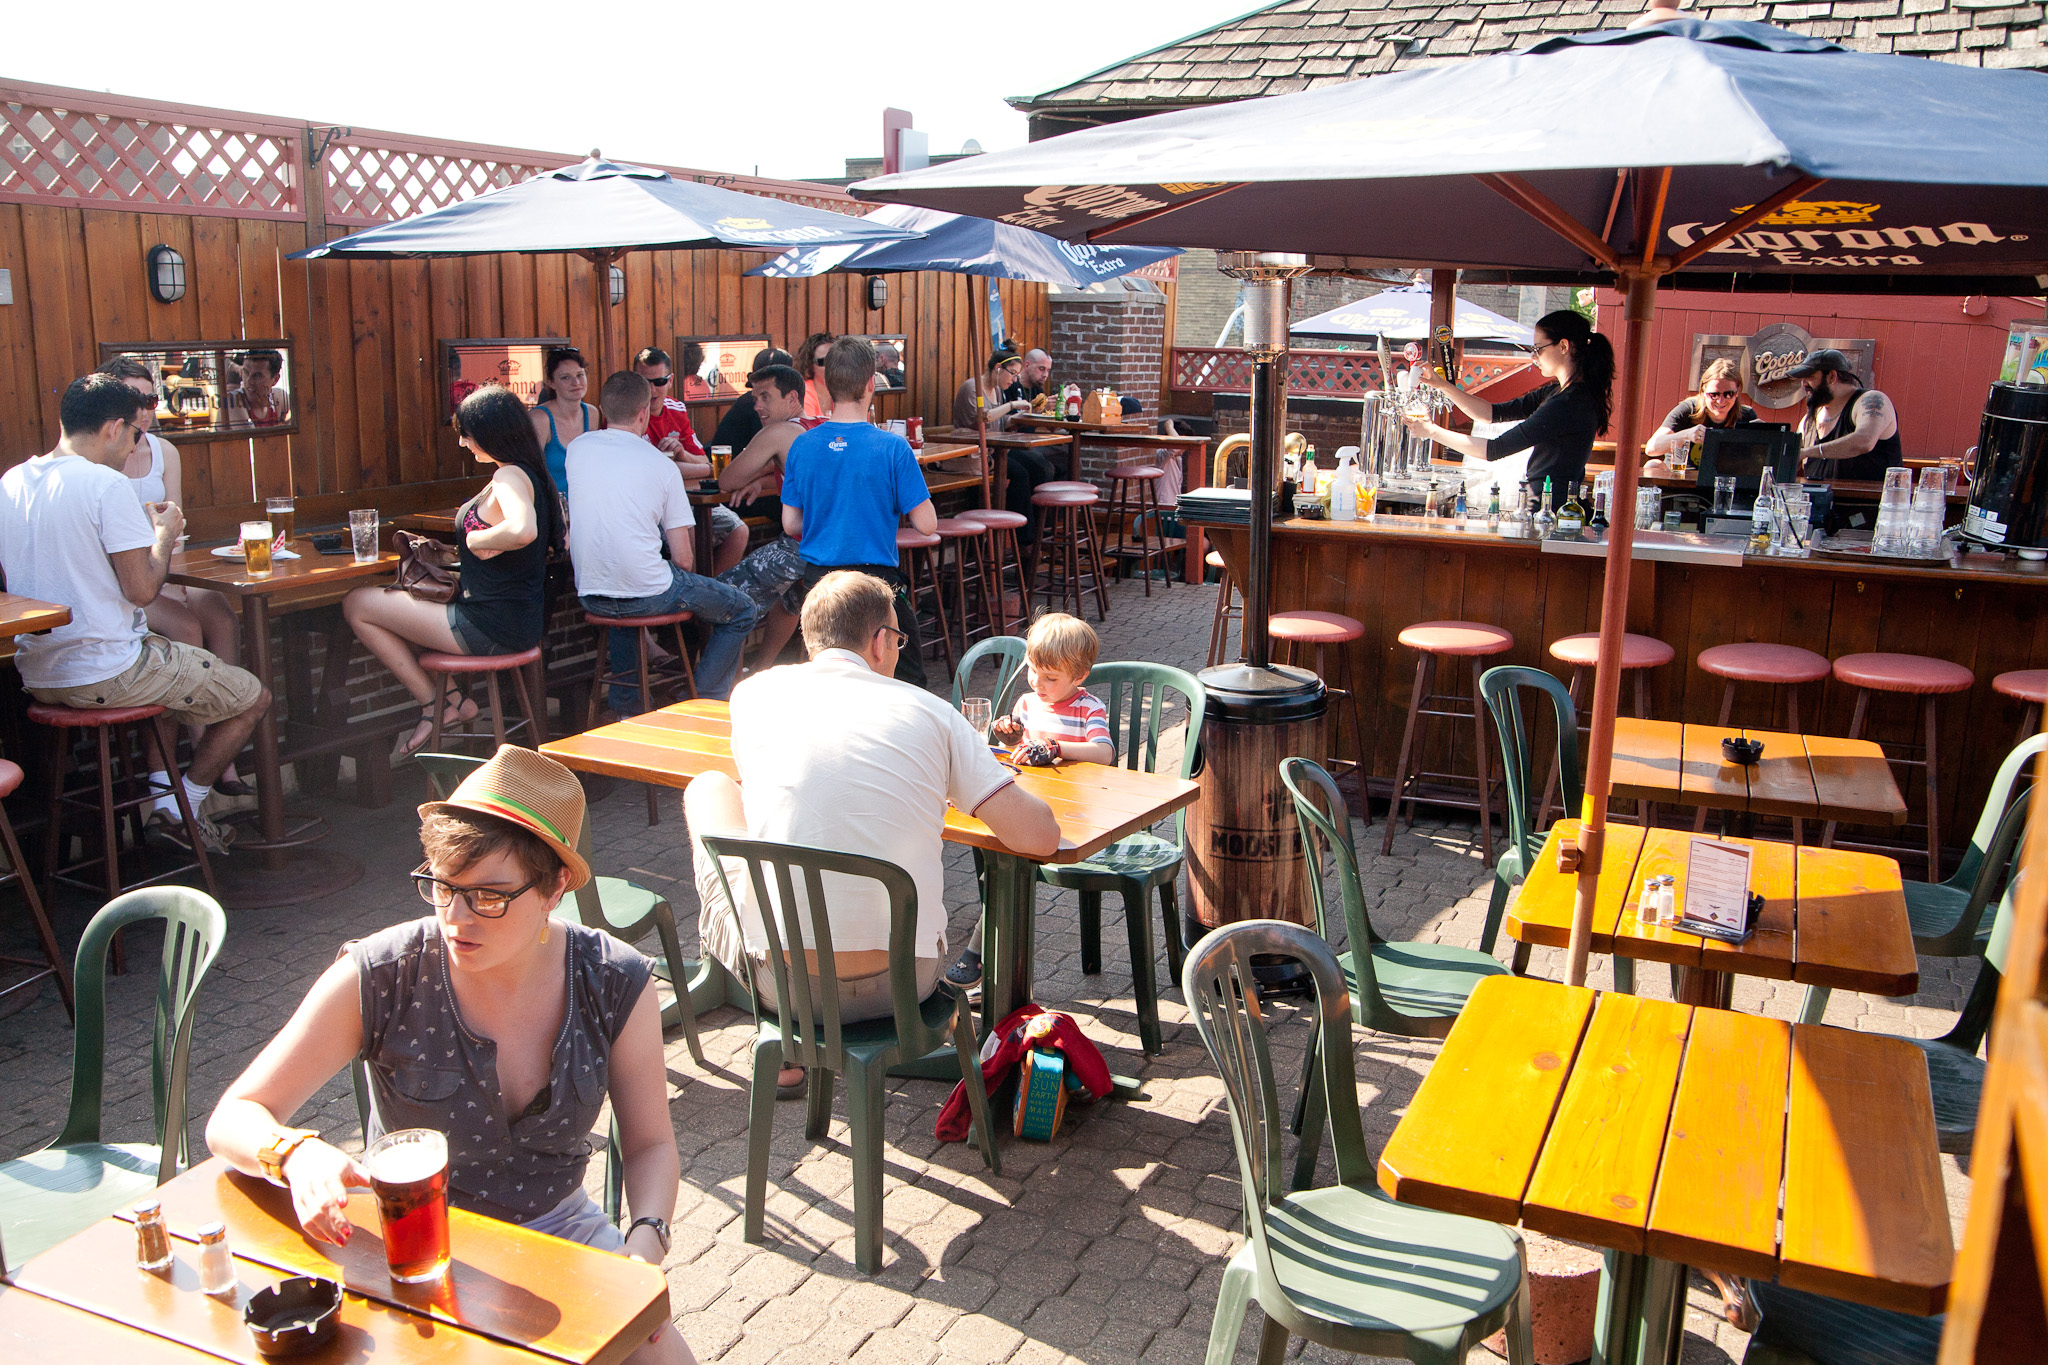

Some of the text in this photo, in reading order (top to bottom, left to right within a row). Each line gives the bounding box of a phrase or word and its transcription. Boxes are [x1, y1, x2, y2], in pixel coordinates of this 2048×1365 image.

[1668, 222, 2006, 257] Corona
[1057, 239, 1130, 268] Cor
[1768, 250, 1924, 267] Extra
[1089, 257, 1126, 275] Extra
[1755, 350, 1805, 374] Coors
[1032, 1078, 1059, 1091] SUN
[1034, 1071, 1061, 1081] VENUS
[1030, 1090, 1058, 1100] EARTH
[1028, 1105, 1054, 1116] MARS
